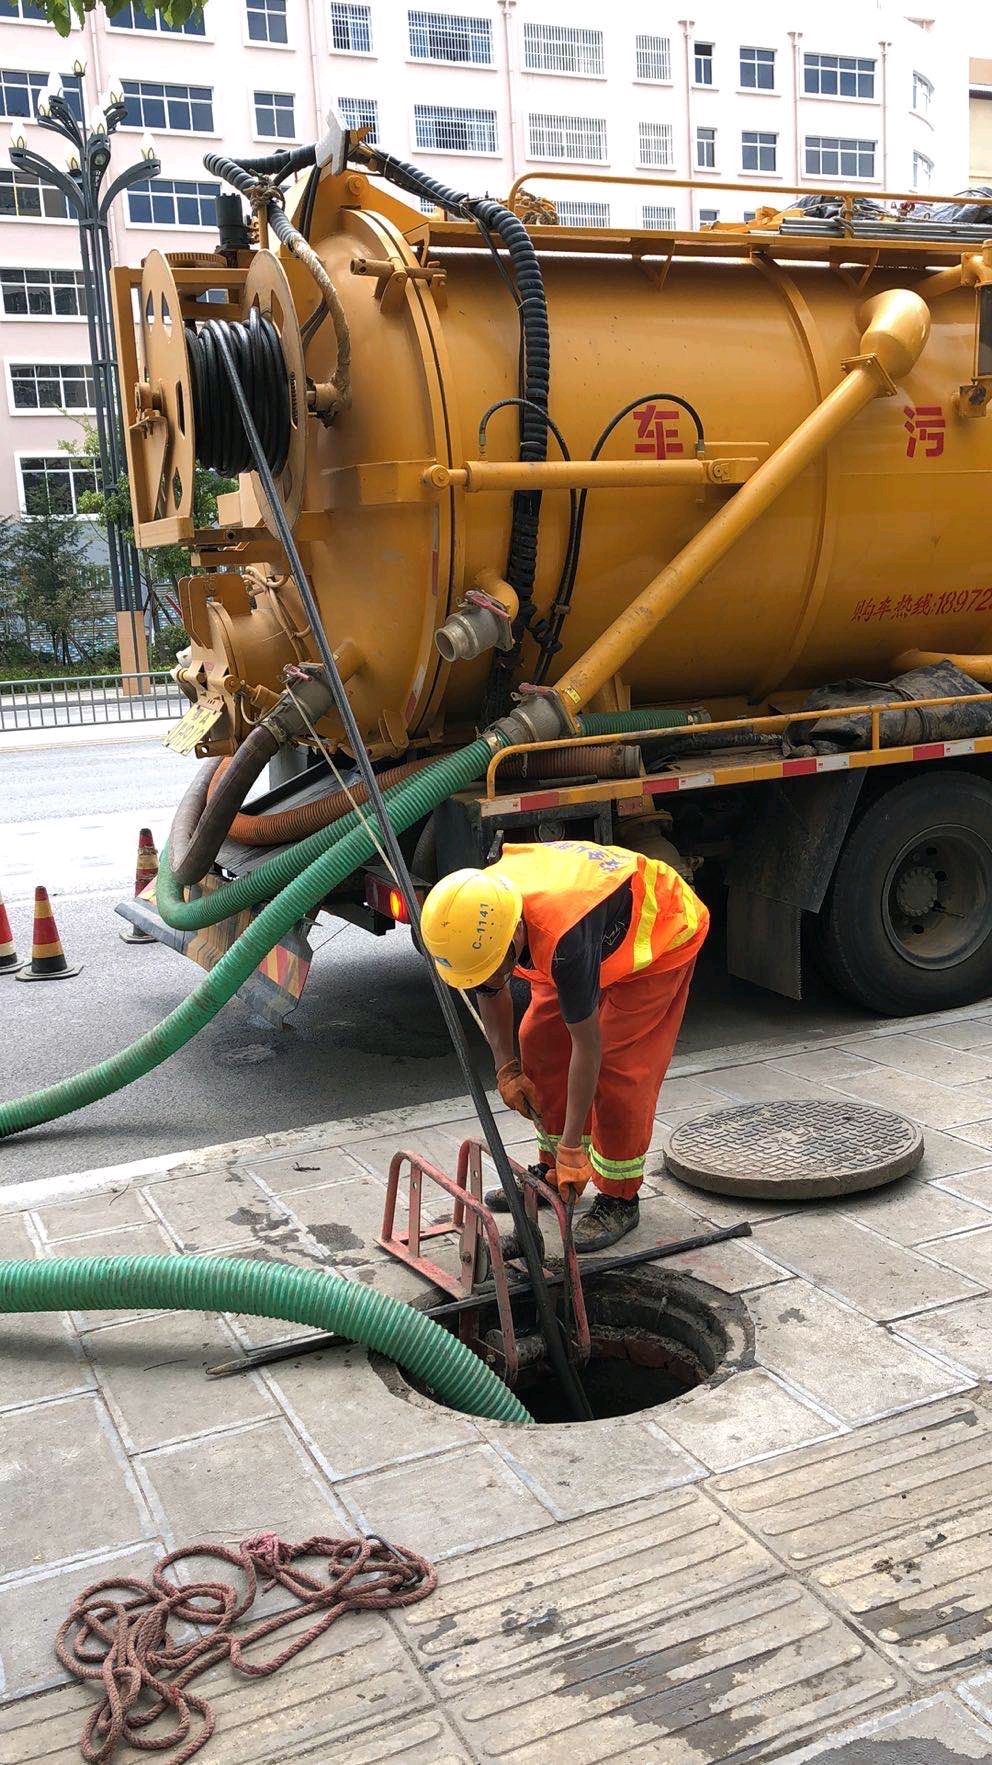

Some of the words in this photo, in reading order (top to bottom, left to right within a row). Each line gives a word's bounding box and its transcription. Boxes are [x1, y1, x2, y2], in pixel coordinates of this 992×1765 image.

[633, 404, 684, 460] 车
[903, 405, 946, 458] 污
[851, 587, 992, 622] 购车热线:18972
[472, 903, 489, 950] C-1141
